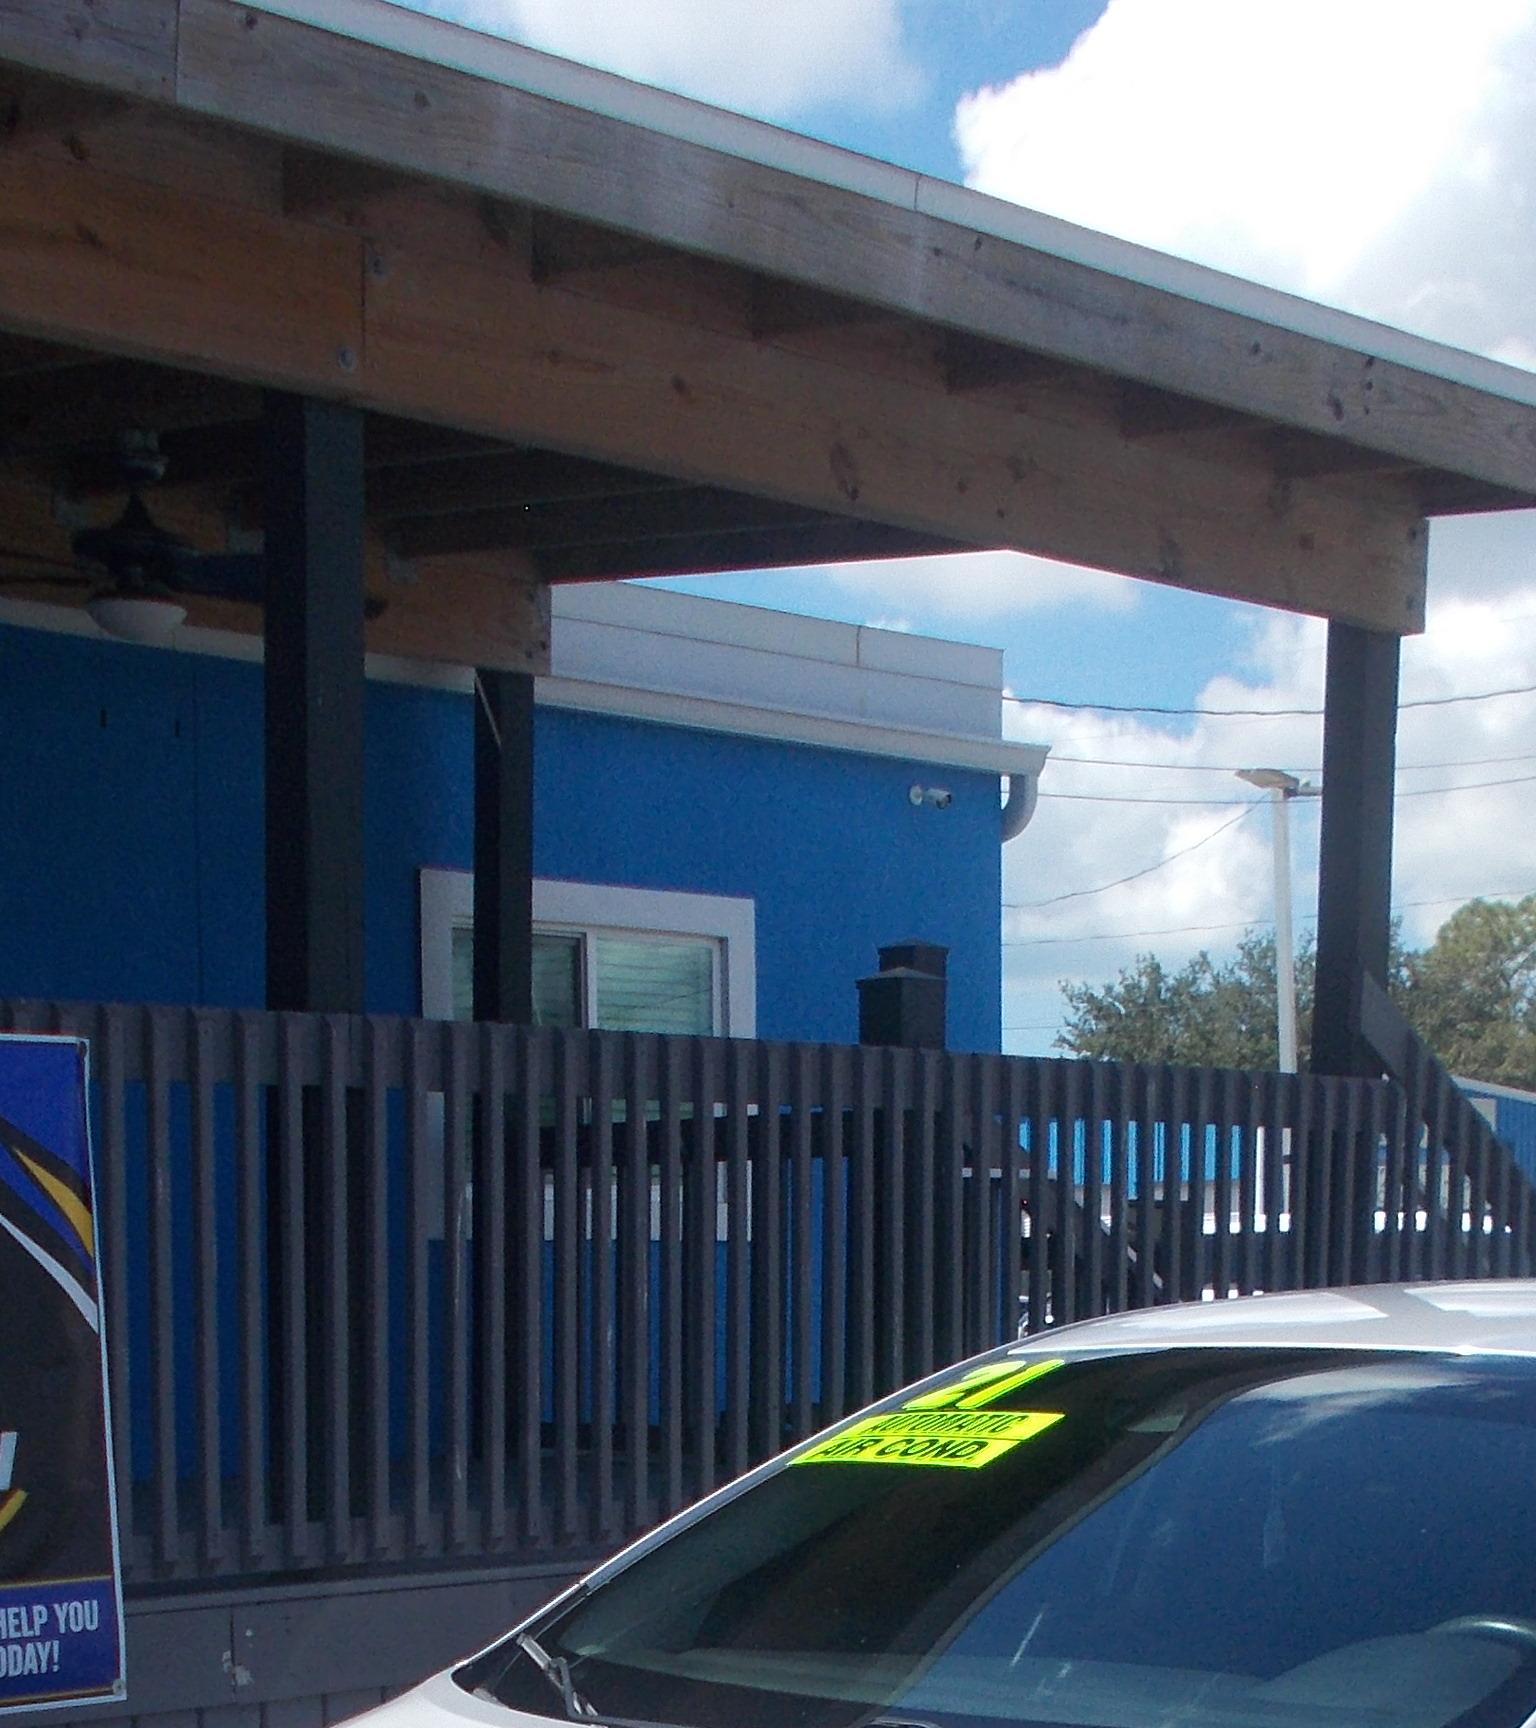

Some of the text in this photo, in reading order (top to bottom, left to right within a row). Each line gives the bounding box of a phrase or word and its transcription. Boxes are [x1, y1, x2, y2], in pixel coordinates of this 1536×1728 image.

[861, 1413, 1029, 1436] AUTOMATIC
[814, 1438, 884, 1458] AIR
[55, 1599, 100, 1635] YOU
